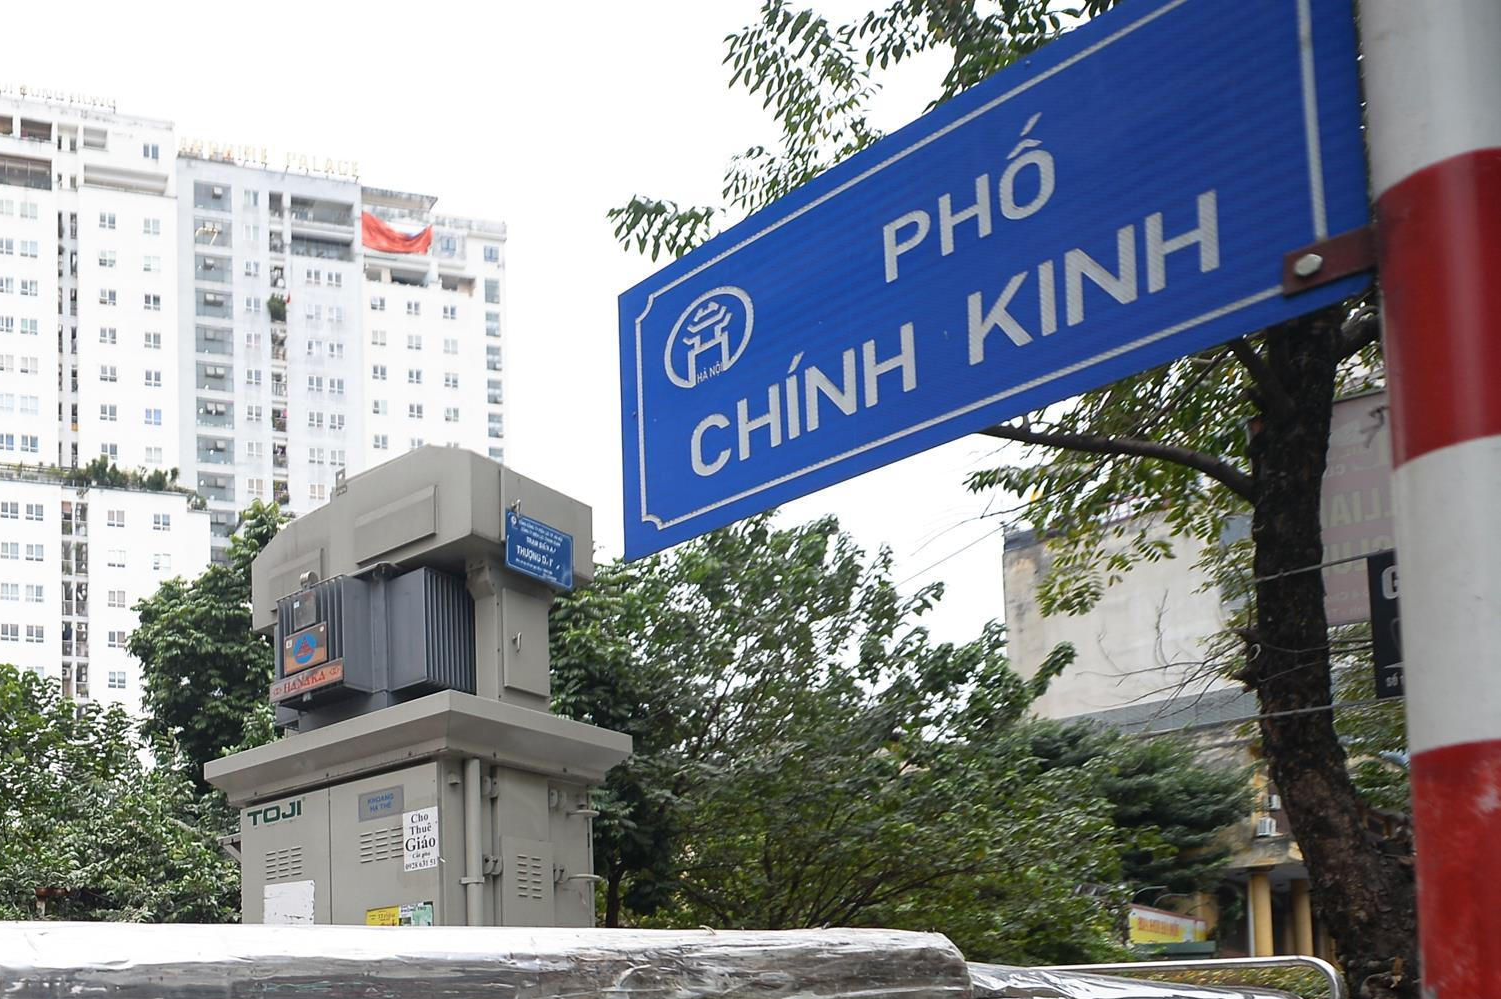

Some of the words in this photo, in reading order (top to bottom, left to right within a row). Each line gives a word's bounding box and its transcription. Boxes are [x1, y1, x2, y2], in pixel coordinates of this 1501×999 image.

[883, 112, 1055, 283] PHỐ
[690, 322, 917, 477] CHÍNH
[967, 190, 1220, 366] KINH
[247, 799, 302, 826] TOJI
[410, 813, 429, 824] Cho
[409, 822, 432, 836] Thuê
[405, 834, 436, 852] Giáo
